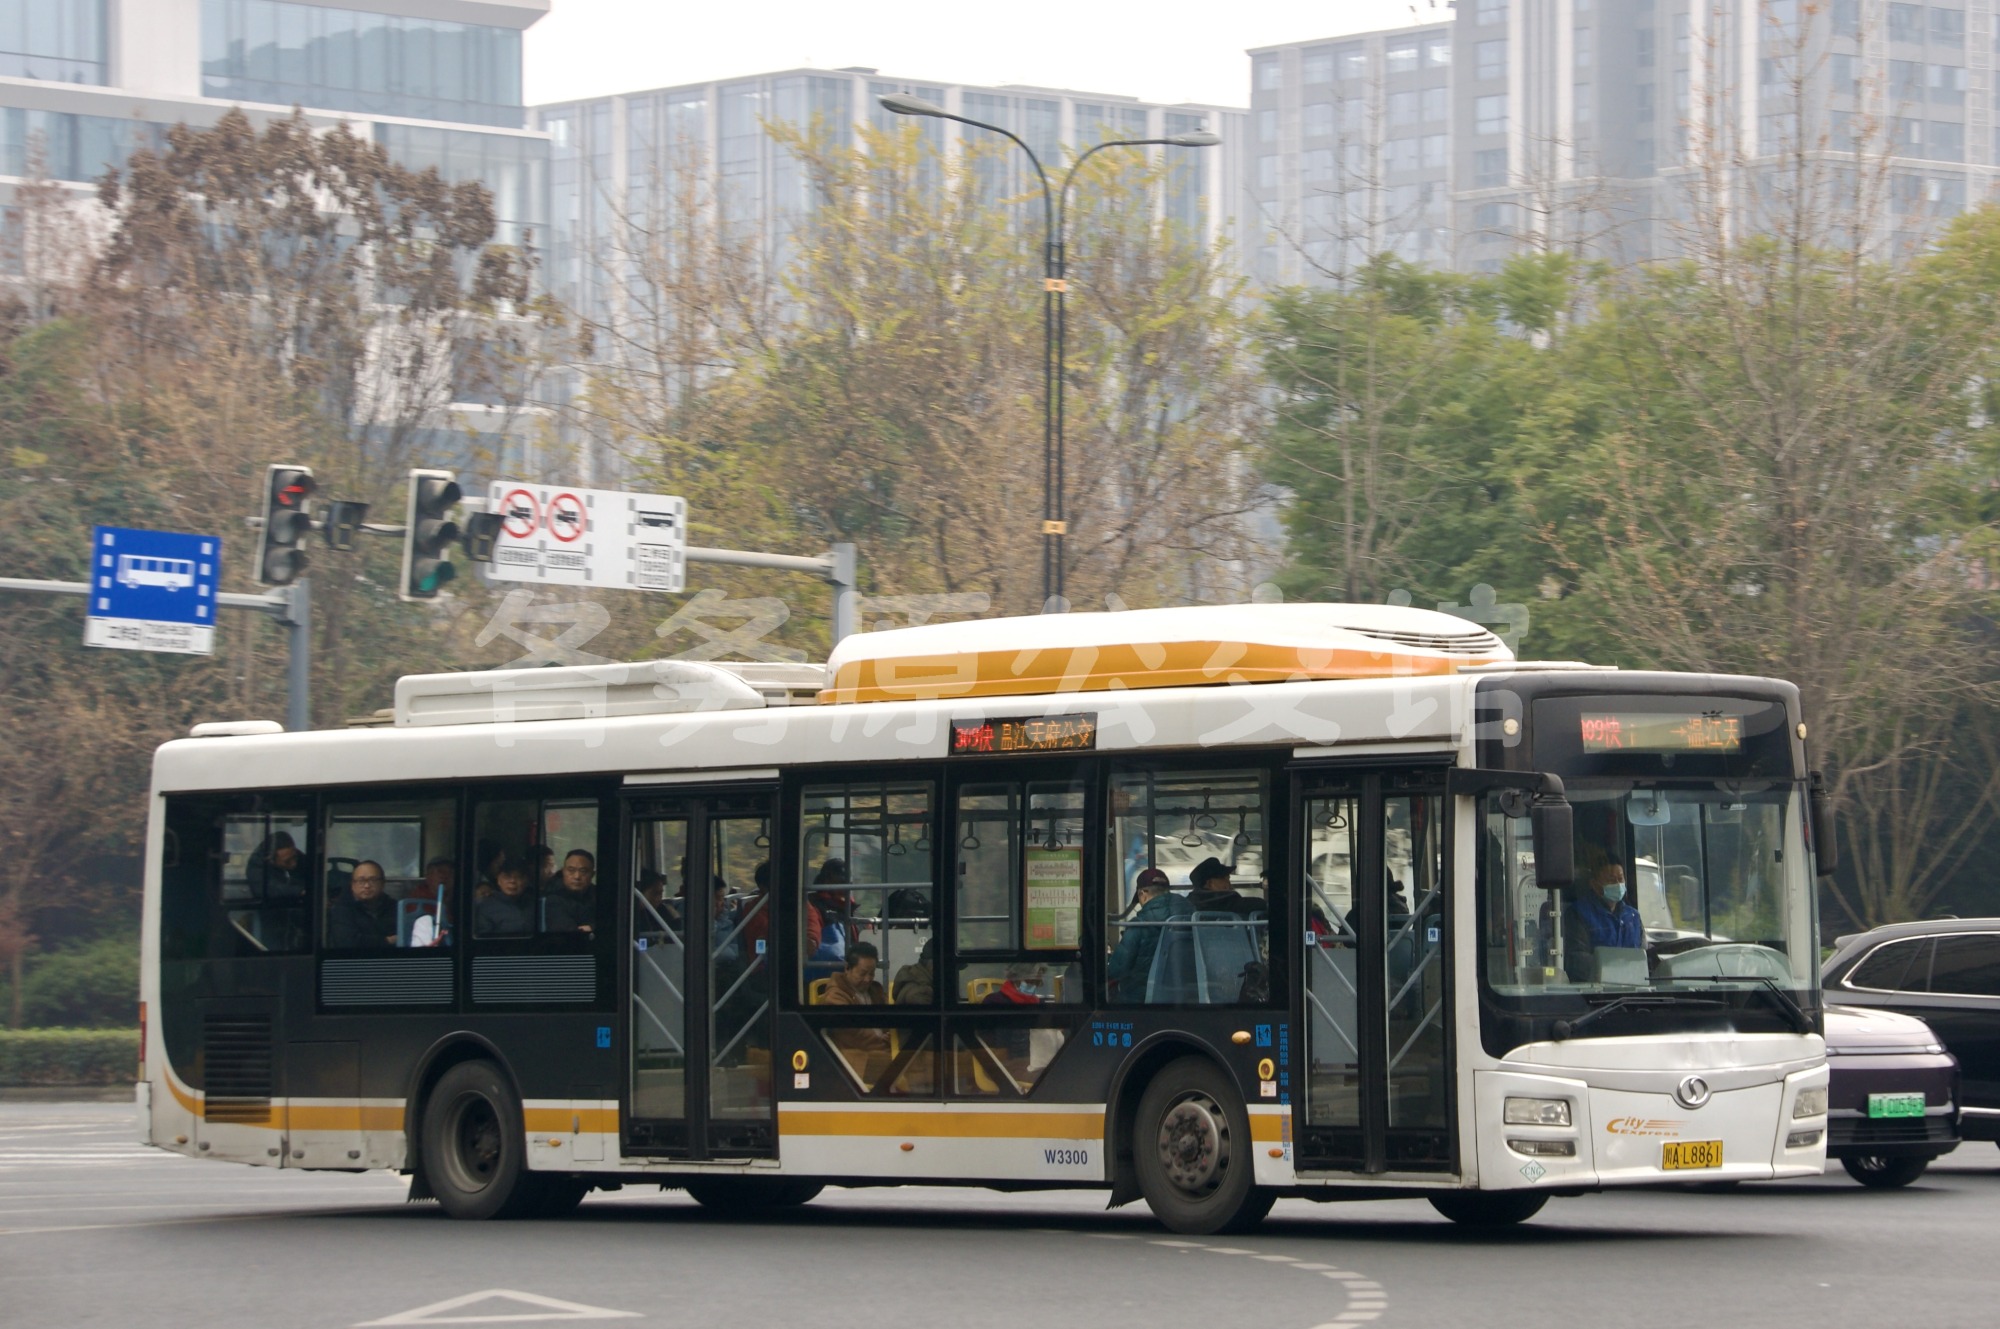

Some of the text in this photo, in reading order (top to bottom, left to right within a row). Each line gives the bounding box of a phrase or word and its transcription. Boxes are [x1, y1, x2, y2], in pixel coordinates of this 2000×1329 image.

[1606, 1116, 1645, 1134] City
[1044, 1149, 1088, 1165] W3300
[1524, 1166, 1541, 1176] CNG
